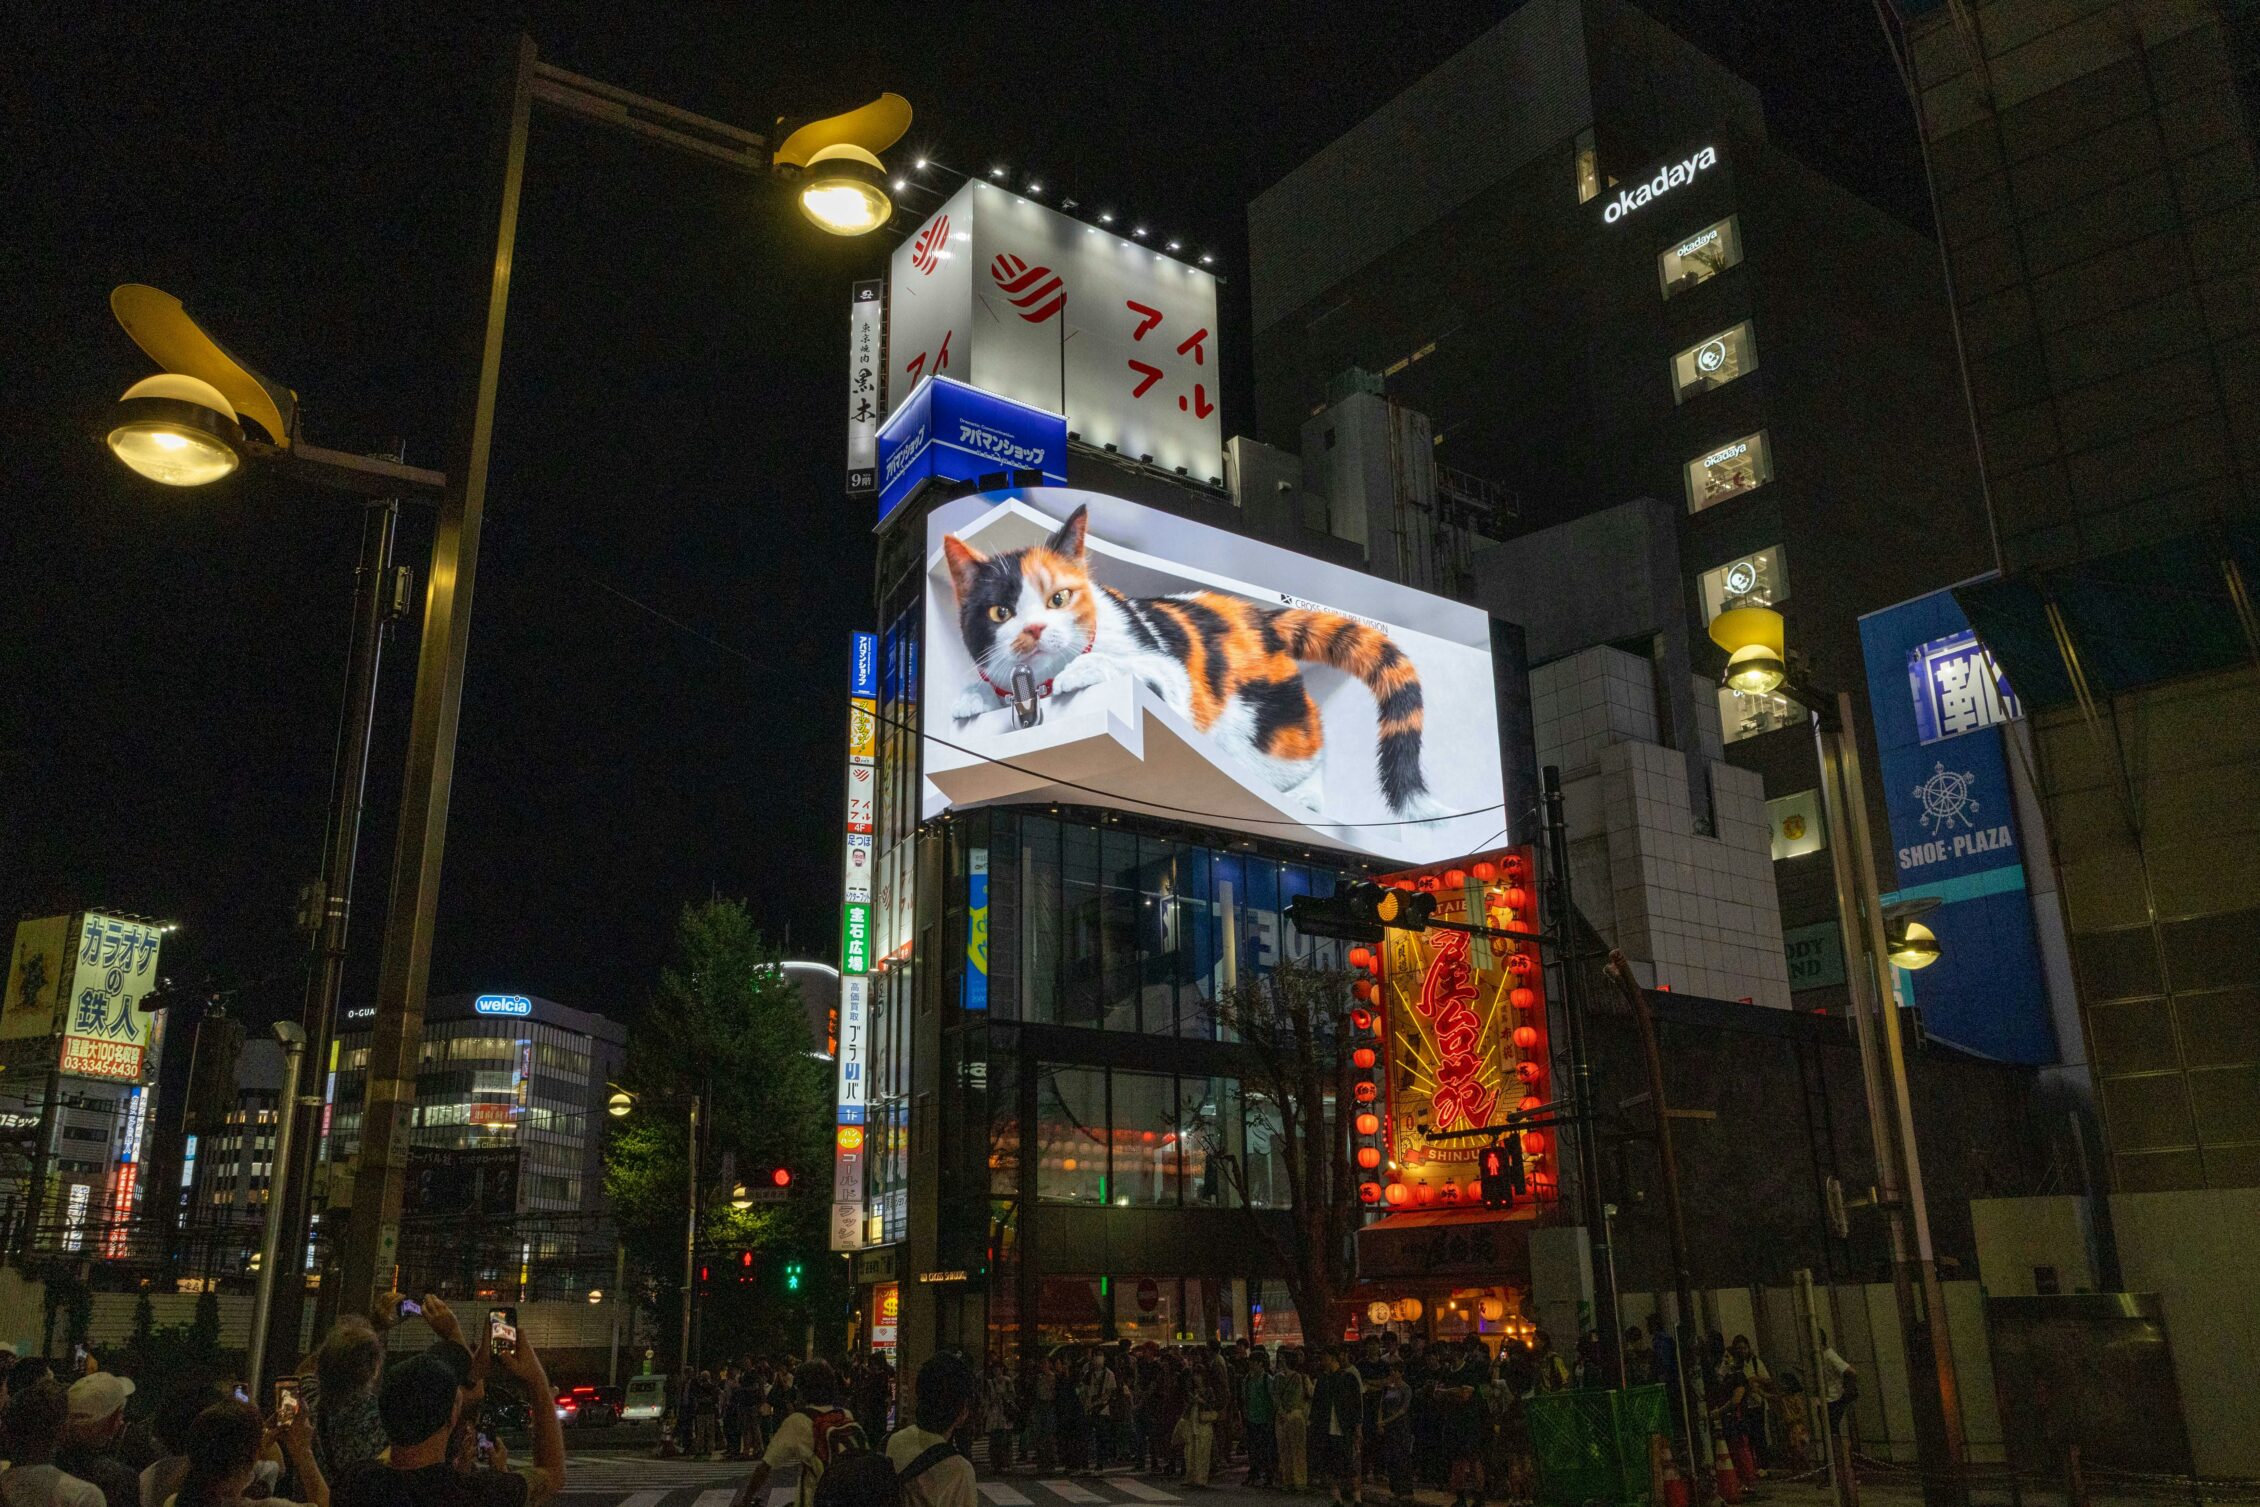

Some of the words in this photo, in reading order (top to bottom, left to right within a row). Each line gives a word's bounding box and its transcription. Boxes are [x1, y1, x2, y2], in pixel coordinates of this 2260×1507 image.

[1603, 145, 1717, 224] okadaya
[1675, 228, 1718, 258] okadaya
[850, 367, 876, 424] 黒木
[885, 424, 926, 481] アパマンショップ
[959, 424, 1046, 465] アパマンショップ
[1703, 443, 1747, 468] okadaya
[851, 472, 872, 487] 9階
[1295, 599, 1320, 613] CROSS
[1363, 616, 1389, 634] VISION
[854, 823, 866, 832] 4F
[80, 915, 159, 976] カラオケ
[848, 906, 864, 972] 宝石広場
[105, 967, 125, 998] の
[74, 988, 139, 1043] 鉄人
[348, 1007, 378, 1018] O-GUA
[479, 997, 527, 1014] welcia
[849, 982, 860, 1021] 高価買取
[64, 1056, 138, 1077] 03-3345-6430
[845, 1024, 861, 1100] ブラリバ
[846, 1108, 858, 1121] 1F
[1428, 1149, 1480, 1162] SHINJU
